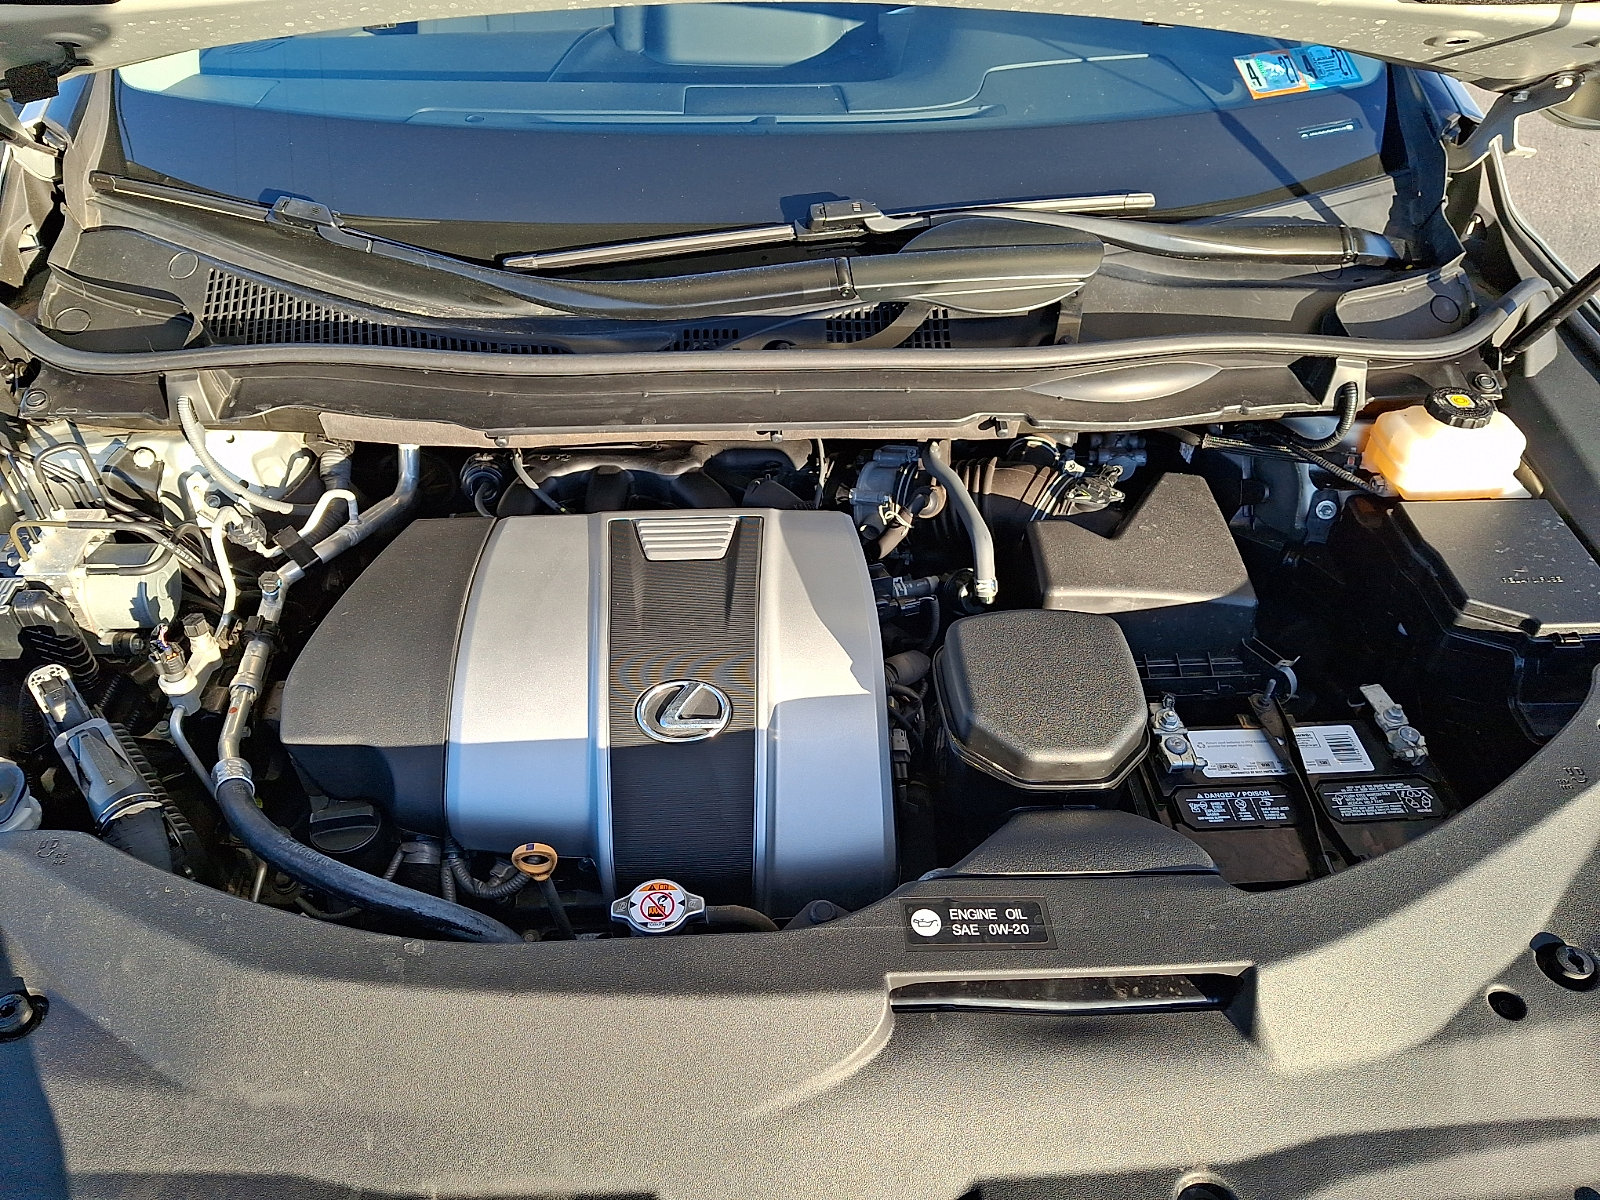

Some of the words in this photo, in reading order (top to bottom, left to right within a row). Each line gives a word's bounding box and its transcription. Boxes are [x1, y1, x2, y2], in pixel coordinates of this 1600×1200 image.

[1246, 62, 1262, 87] 4
[1278, 54, 1300, 84] 27
[1301, 54, 1319, 80] 4
[1204, 791, 1236, 799] DANGER
[1242, 790, 1271, 798] POISON
[949, 908, 998, 920] ENGINE
[1005, 908, 1028, 920] OIL
[952, 923, 981, 936] SAE
[988, 923, 1030, 936] 0W-20
